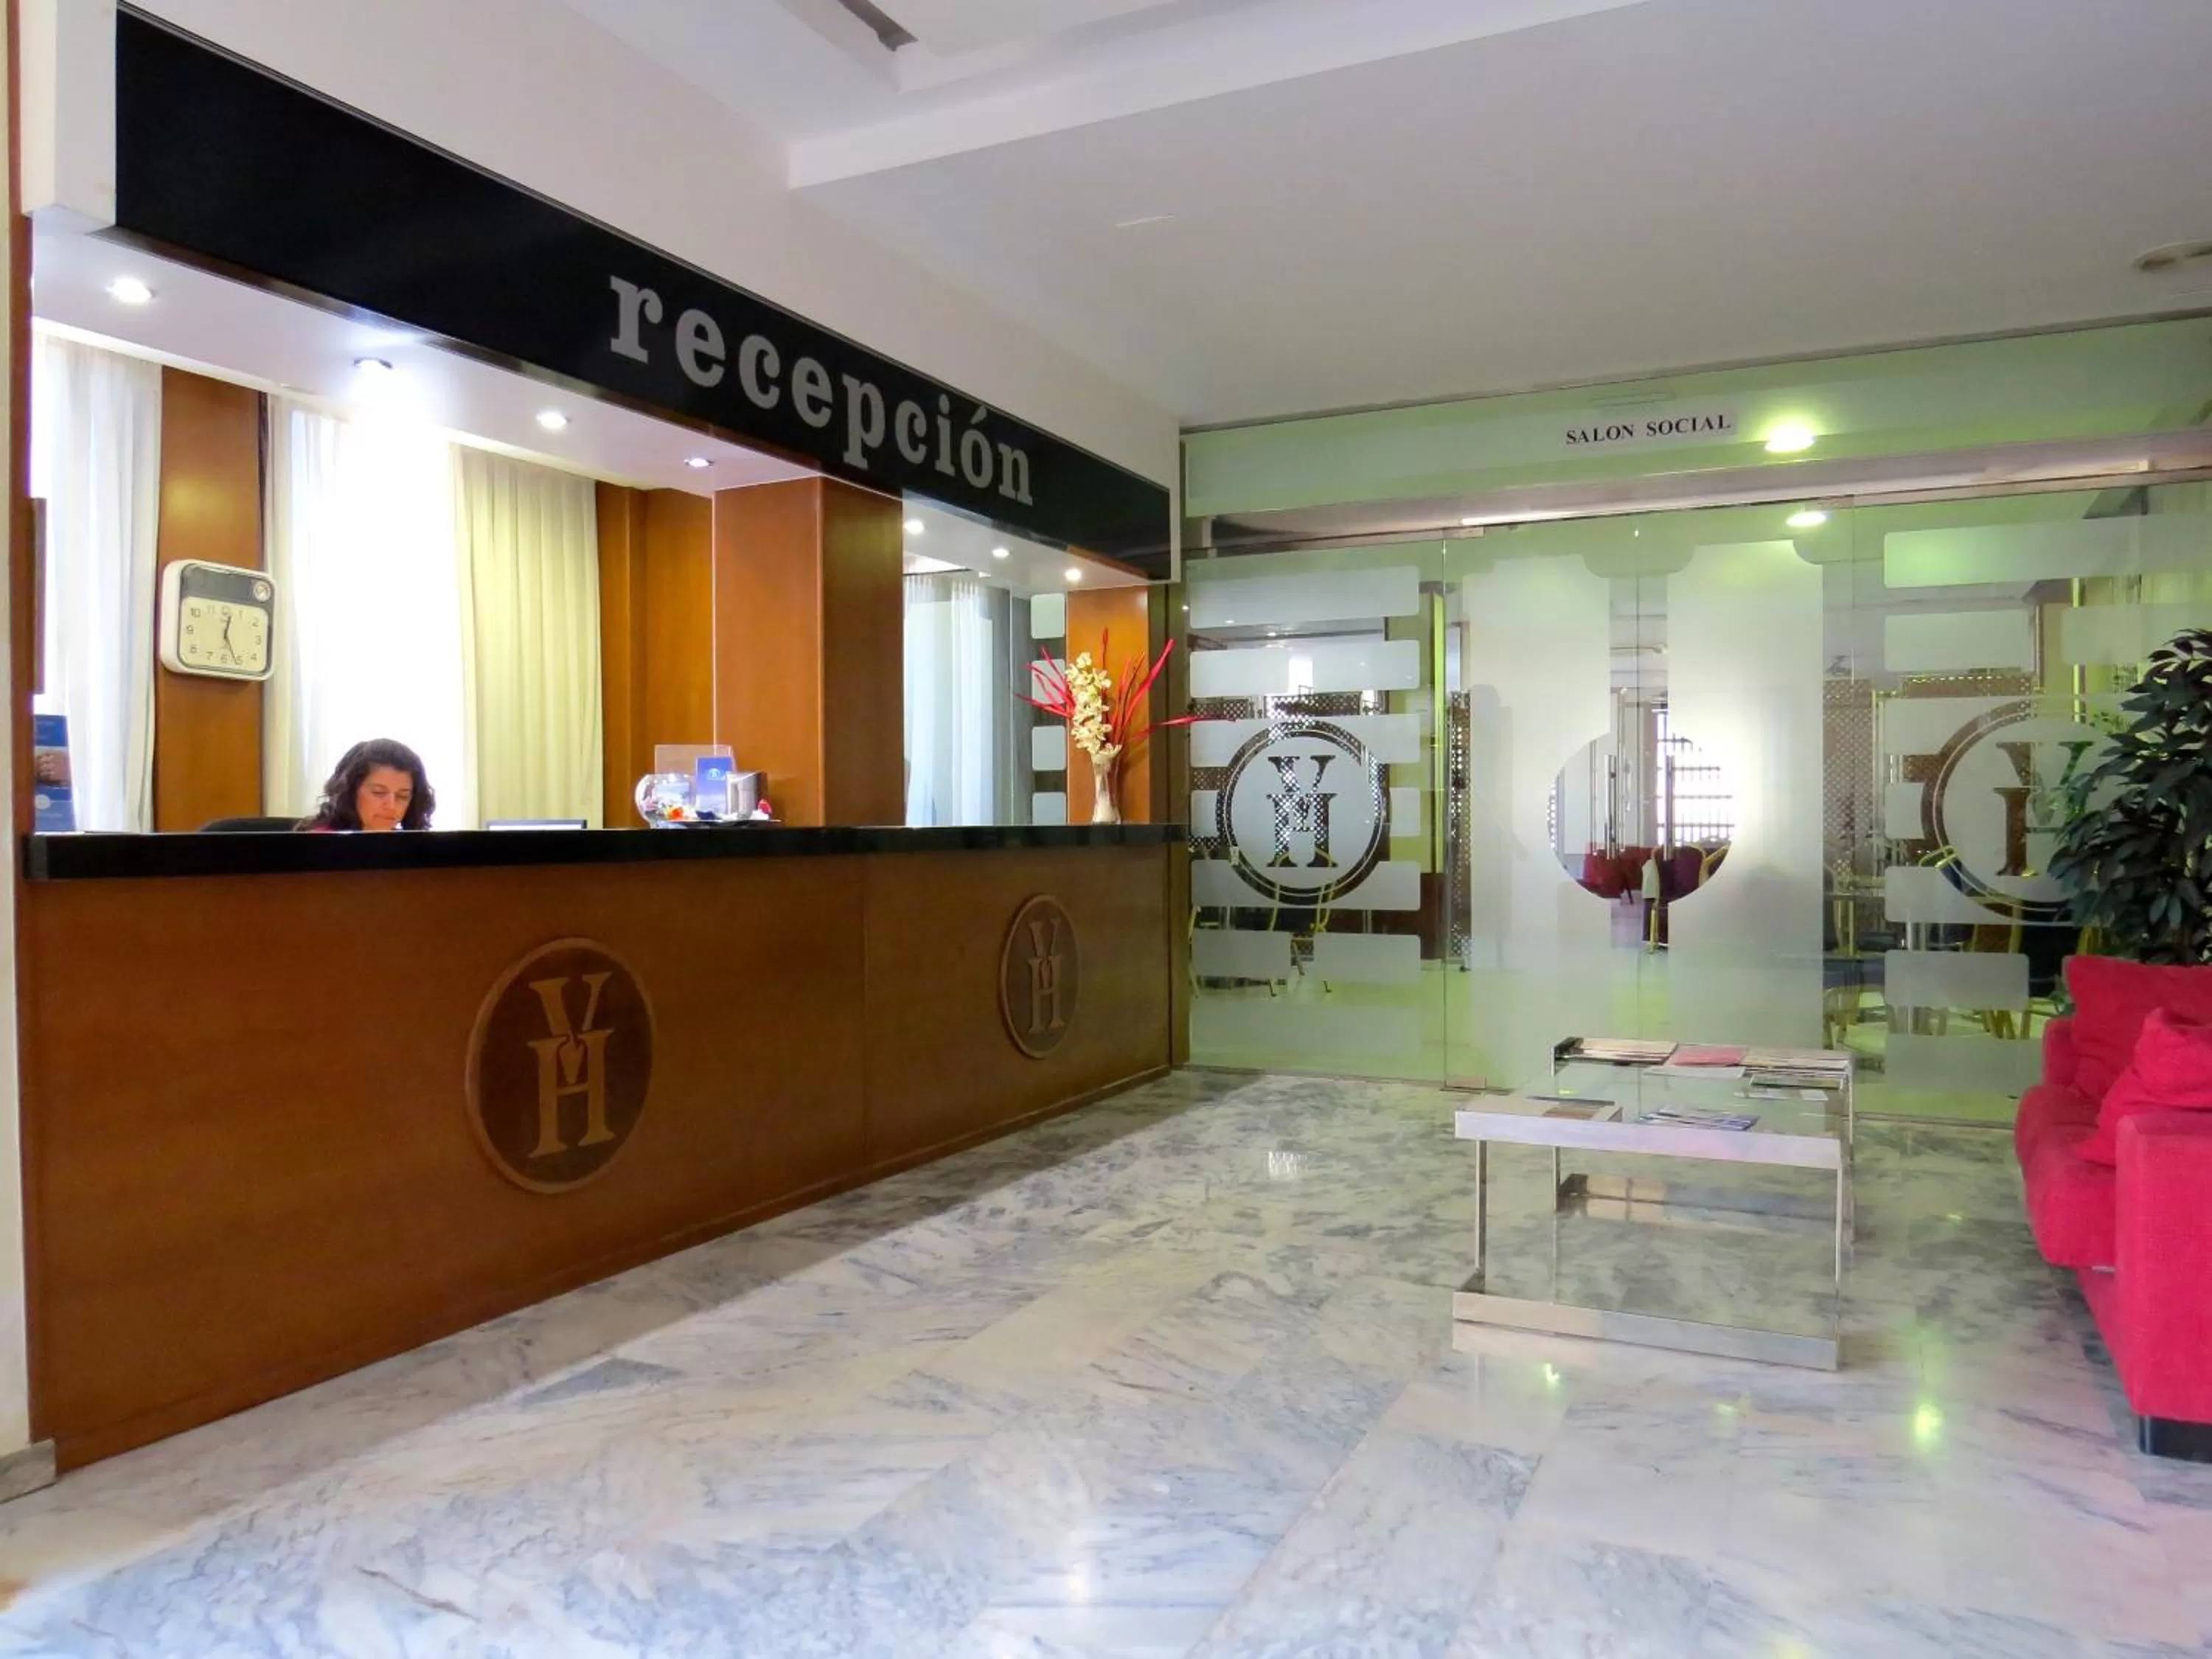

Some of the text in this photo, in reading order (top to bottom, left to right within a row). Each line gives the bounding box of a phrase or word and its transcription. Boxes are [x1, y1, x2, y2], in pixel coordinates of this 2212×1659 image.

[610, 276, 1033, 506] recepción
[1565, 414, 1731, 444] SALON SOCIAL
